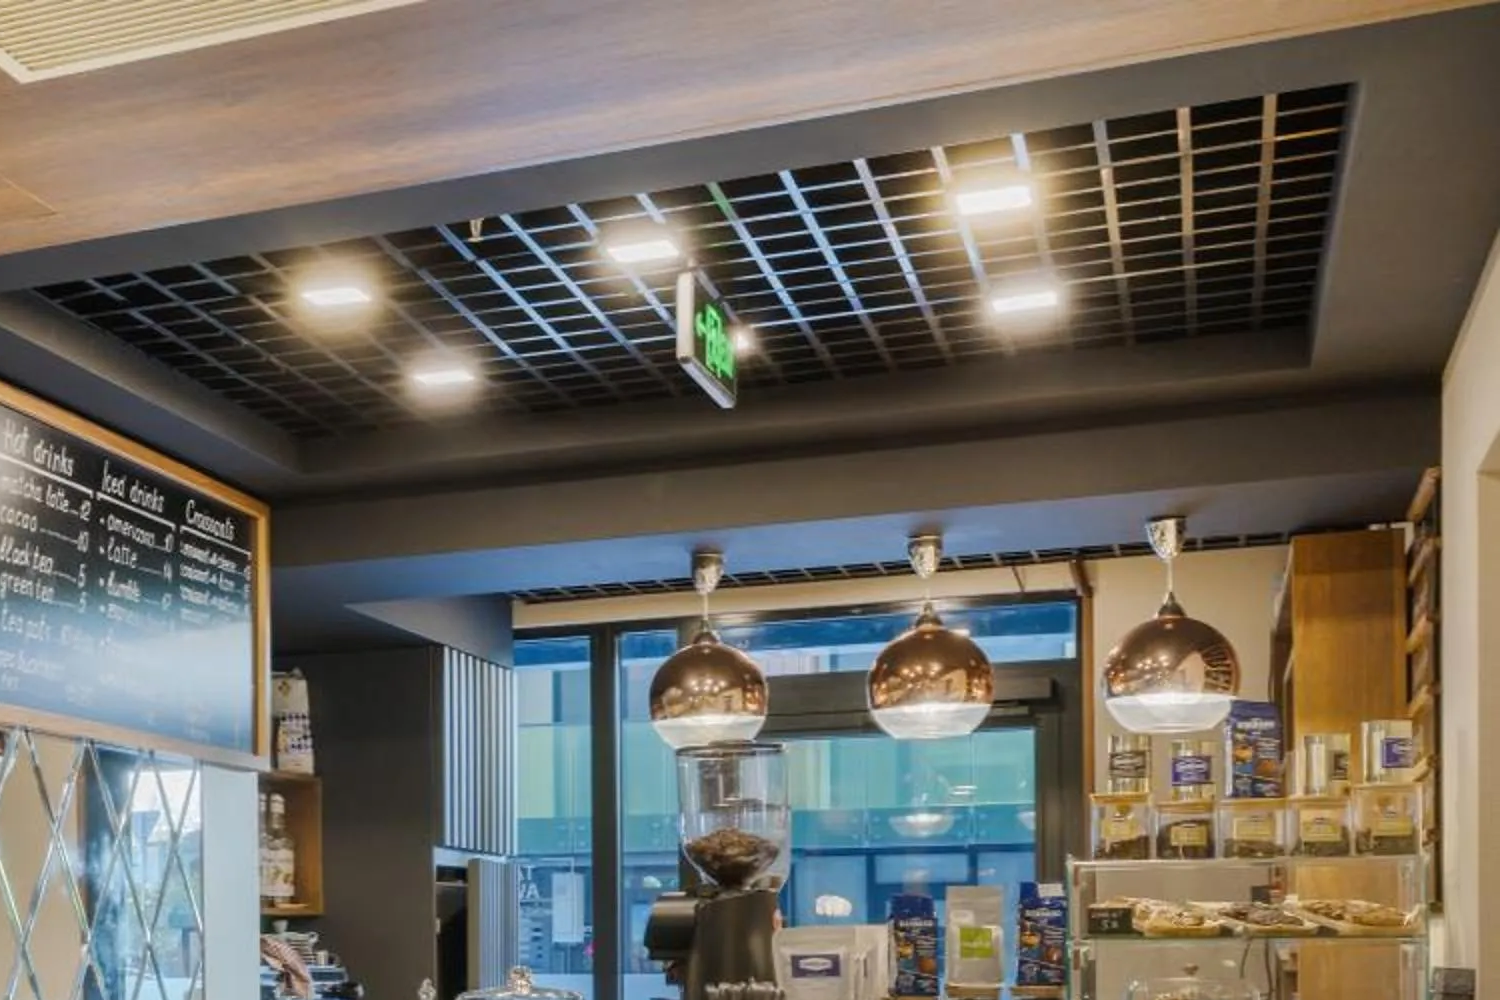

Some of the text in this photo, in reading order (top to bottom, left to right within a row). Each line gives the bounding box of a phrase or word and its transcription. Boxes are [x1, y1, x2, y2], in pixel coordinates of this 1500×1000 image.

[2, 419, 75, 478] Hot drinks
[102, 460, 165, 513] Iced drinks
[0, 505, 38, 533] cacao
